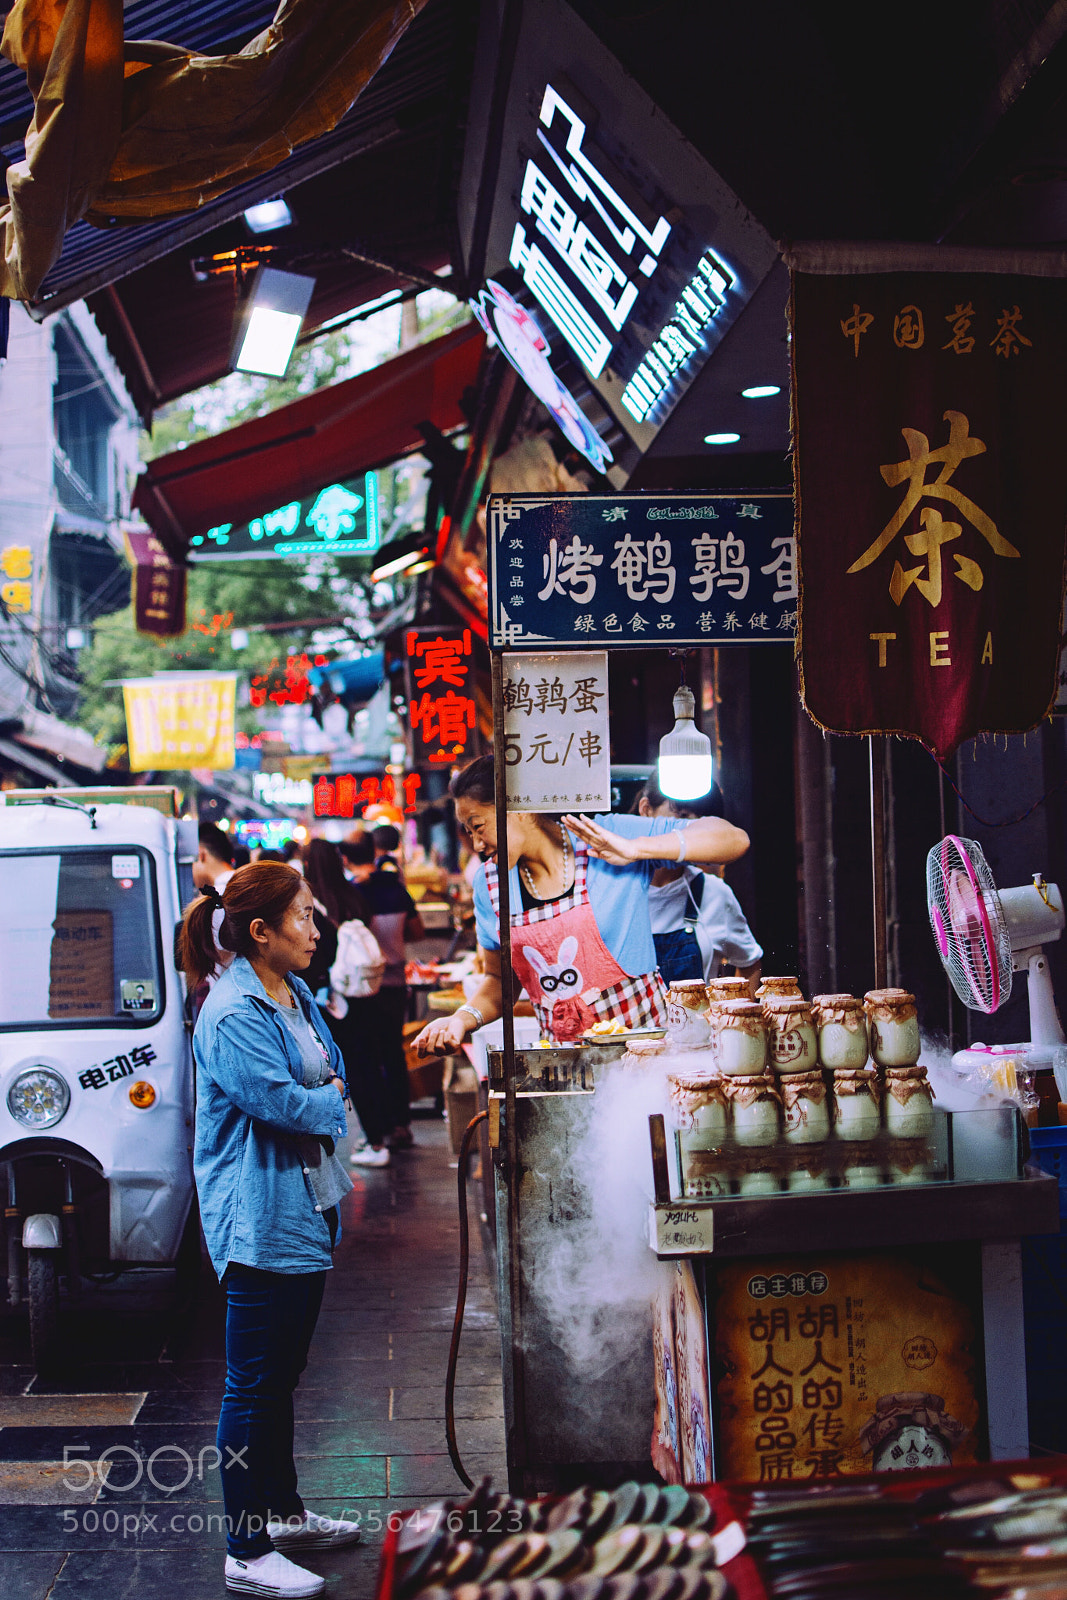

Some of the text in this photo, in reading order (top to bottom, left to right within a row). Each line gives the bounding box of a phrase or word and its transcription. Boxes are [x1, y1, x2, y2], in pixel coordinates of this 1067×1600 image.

[840, 302, 1033, 358] 中国茗茶
[602, 504, 763, 522] 清 真
[846, 410, 1021, 607] 茶
[508, 537, 525, 607] 欢迎品尝
[573, 610, 798, 633] 绿色食品 营养健康
[869, 631, 994, 668] TEA
[411, 633, 474, 746] 宾馆
[502, 676, 605, 716] 鹌鹑蛋
[504, 730, 602, 768] 5元/串
[79, 1043, 157, 1090] 电动车
[663, 1211, 699, 1226] yogurt
[750, 1274, 826, 1296] 店主推荐
[748, 1307, 797, 1482] 胡人的品质
[798, 1304, 845, 1479] 胡人的传承
